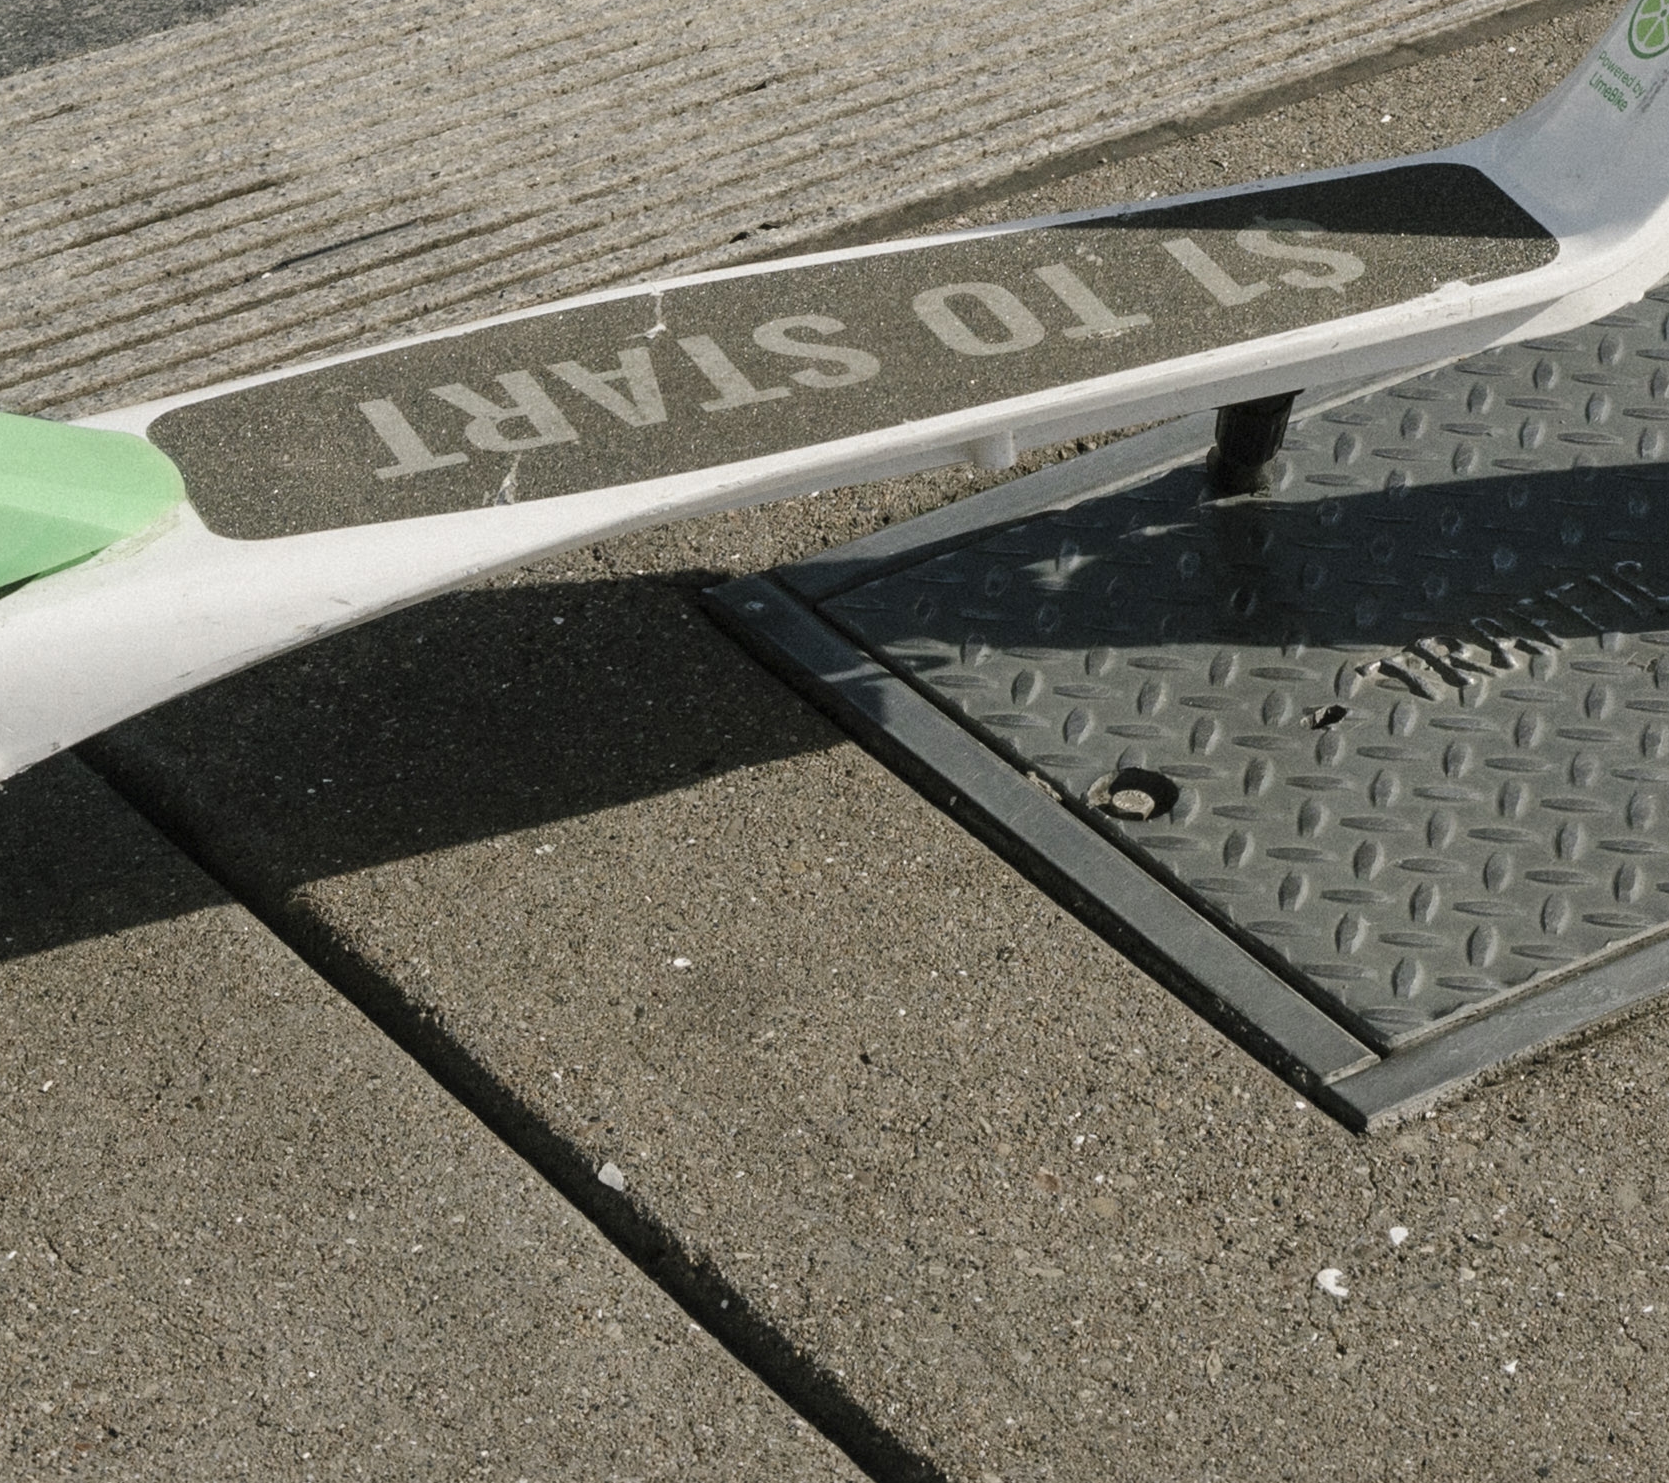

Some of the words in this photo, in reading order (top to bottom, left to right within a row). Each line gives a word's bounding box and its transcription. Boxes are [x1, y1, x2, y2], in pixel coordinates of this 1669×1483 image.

[1588, 70, 1629, 113] LimeBike
[1596, 49, 1637, 89] Powered
[1631, 78, 1647, 100] by
[911, 259, 1153, 357] TO
[1161, 215, 1367, 309] $1
[357, 312, 882, 480] START
